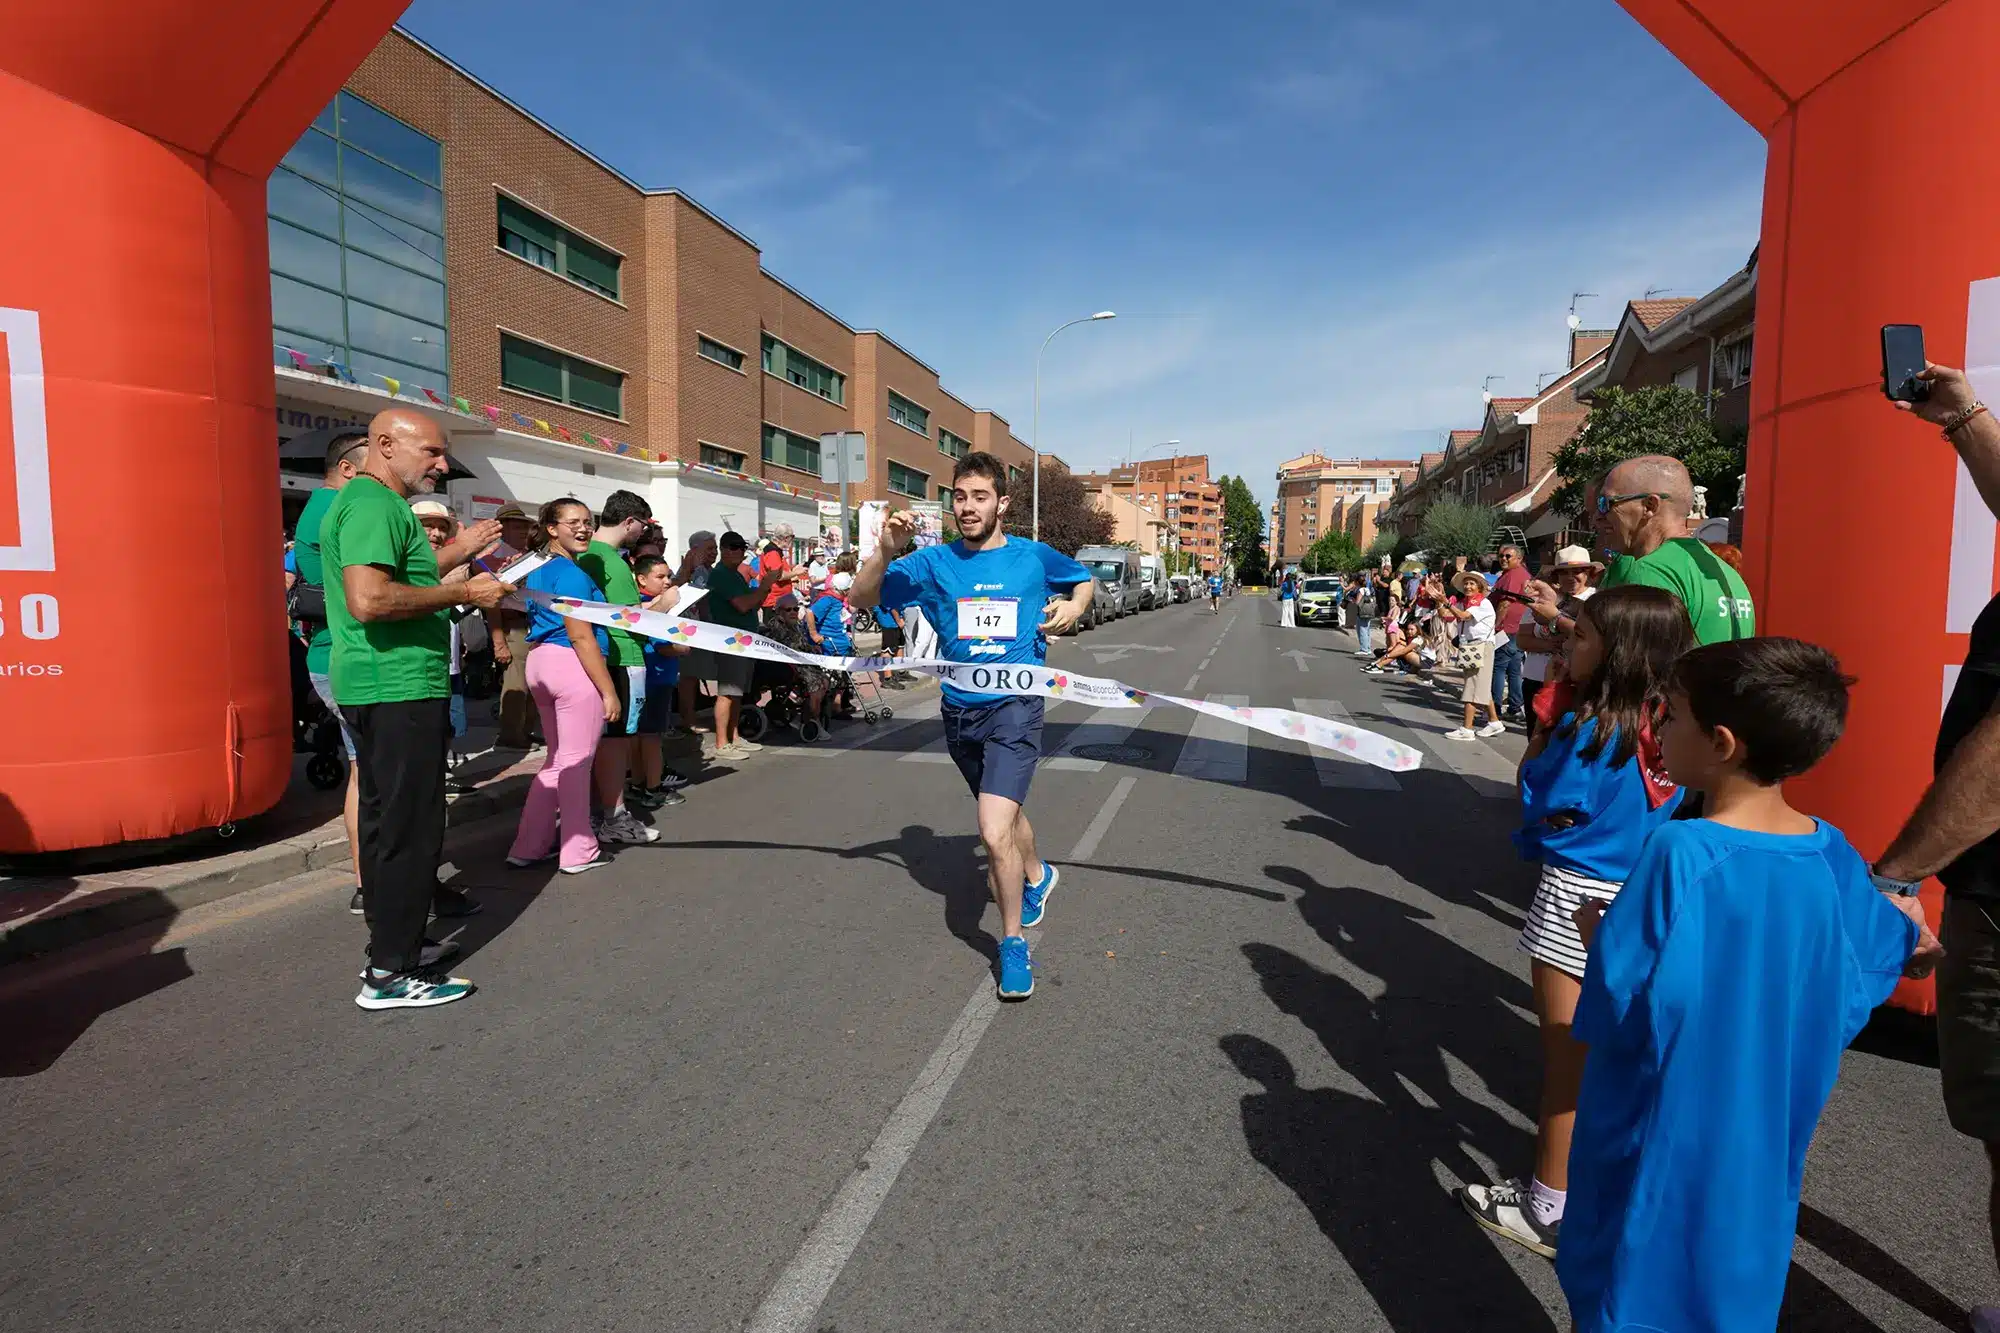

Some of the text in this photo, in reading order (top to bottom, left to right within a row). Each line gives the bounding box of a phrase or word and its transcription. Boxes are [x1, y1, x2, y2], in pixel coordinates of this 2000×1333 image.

[1718, 596, 1751, 618] STAFF
[975, 615, 1001, 627] 147
[972, 668, 1033, 690] ORO
